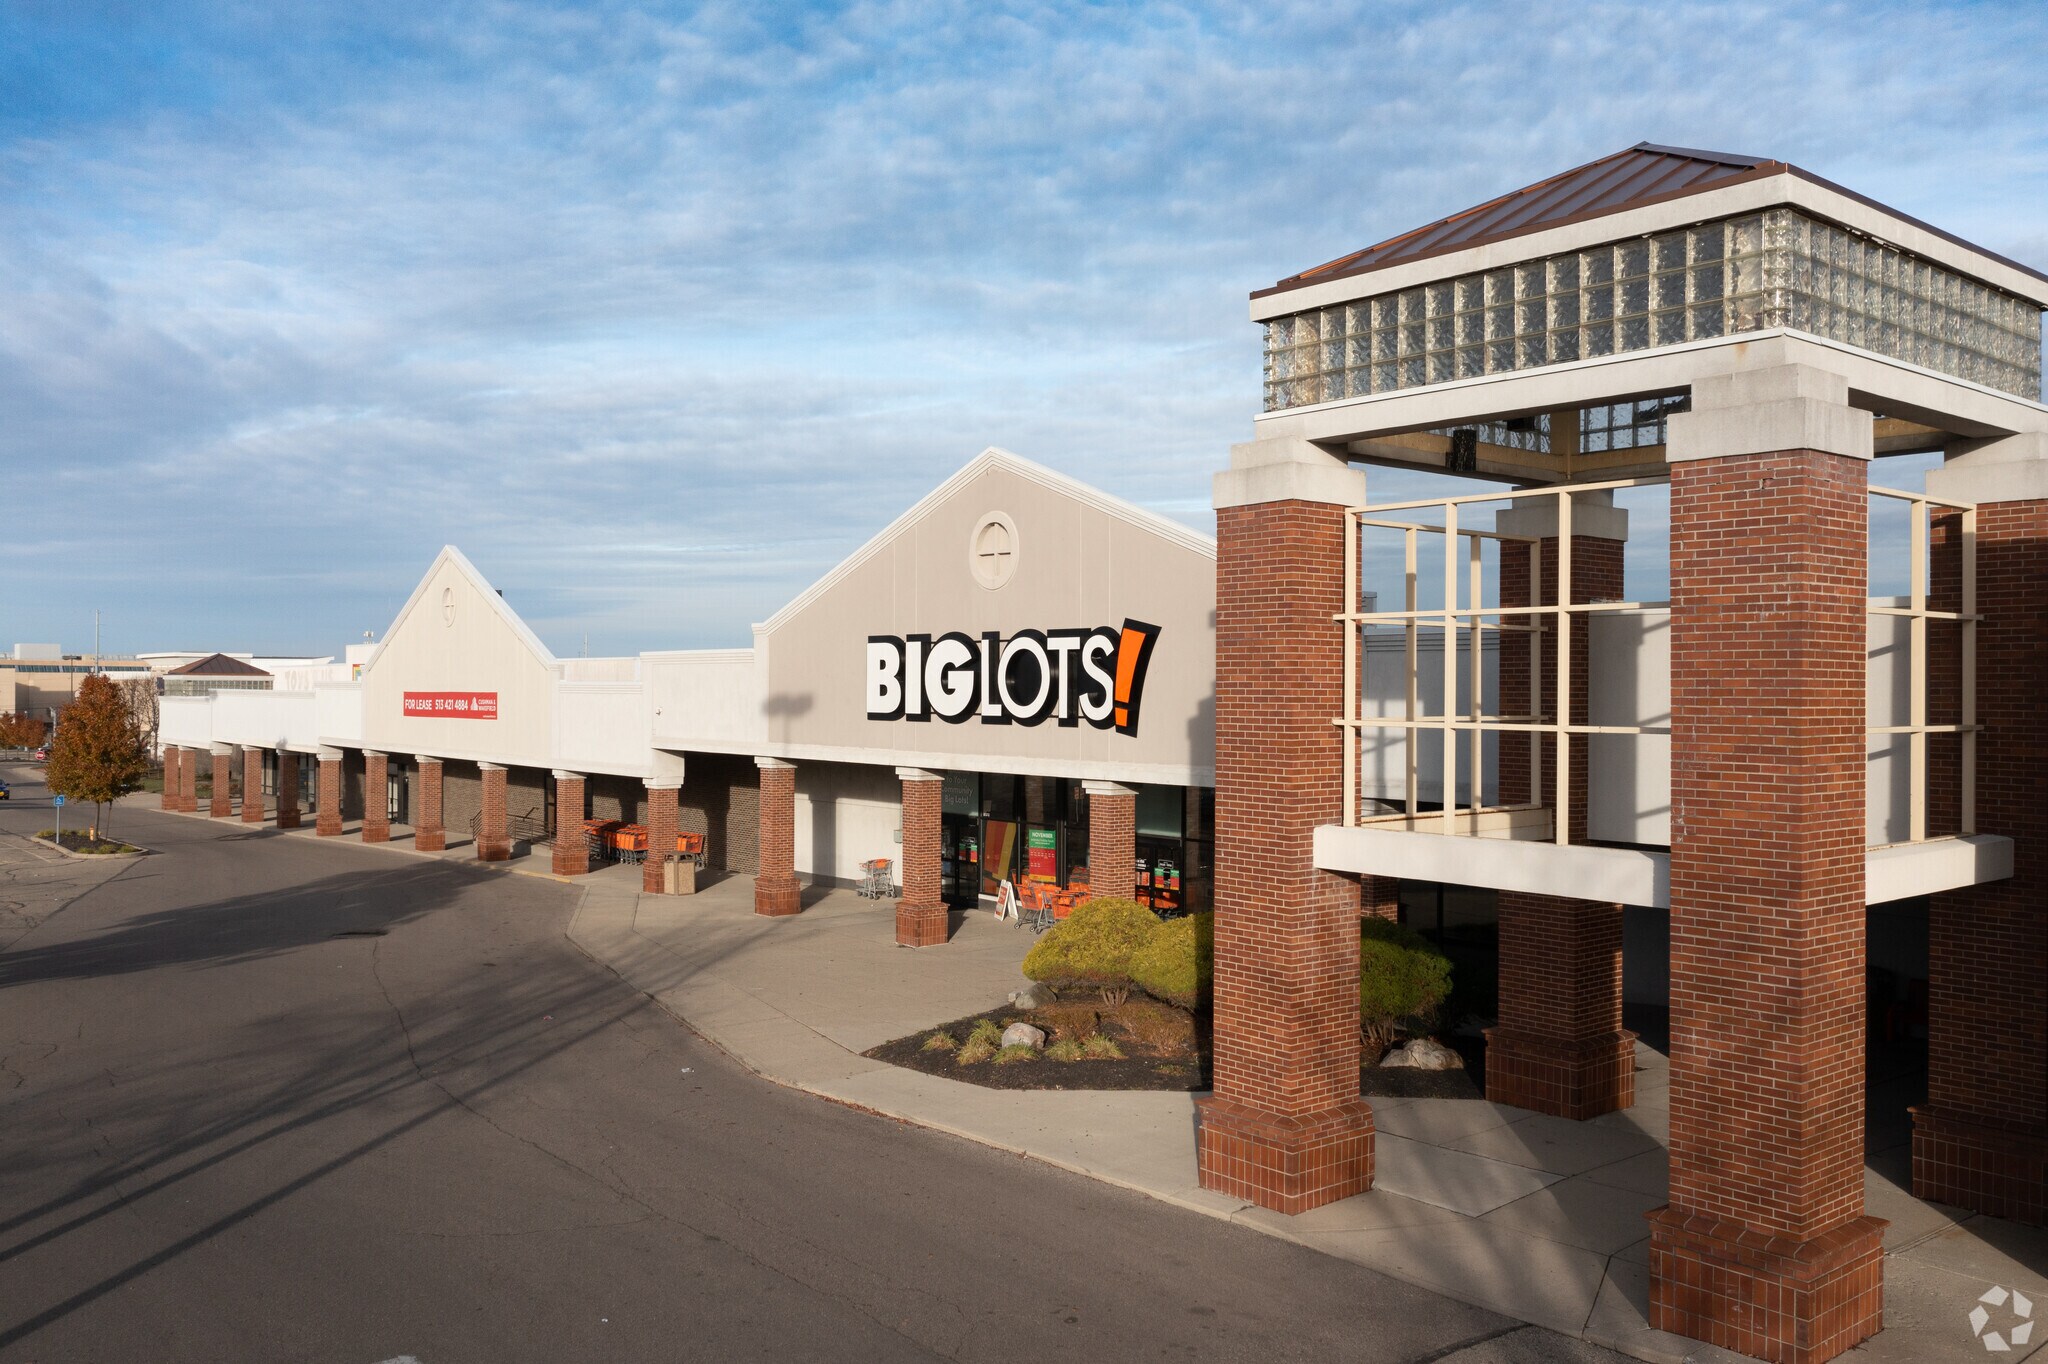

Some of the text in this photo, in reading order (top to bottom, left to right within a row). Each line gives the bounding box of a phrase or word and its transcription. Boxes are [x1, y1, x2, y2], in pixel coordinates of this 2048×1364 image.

[867, 632, 979, 723] BIG
[405, 699, 415, 710] FOR
[416, 699, 432, 710] LEASE
[435, 699, 444, 710] 513
[444, 699, 454, 710] 421
